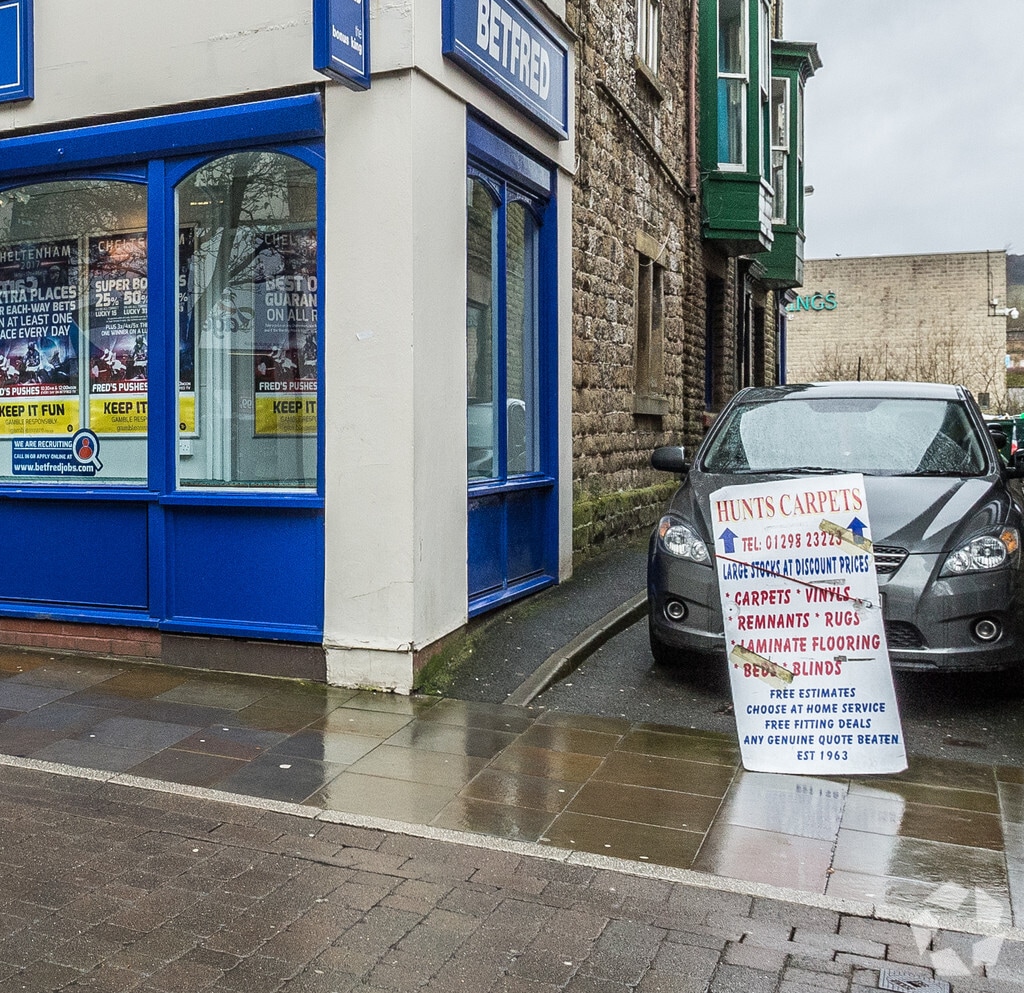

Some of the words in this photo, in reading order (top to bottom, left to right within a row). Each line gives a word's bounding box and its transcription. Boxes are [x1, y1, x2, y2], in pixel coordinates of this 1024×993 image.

[20, 260, 40, 270] 2017
[96, 278, 130, 292] SUPER
[265, 276, 303, 292] BEST
[30, 285, 76, 302] PLACES
[96, 293, 119, 307] 25%
[6, 302, 50, 315] EACH-WAY
[53, 300, 76, 312] BETS
[7, 316, 18, 328] AT
[20, 314, 49, 326] LEAST
[52, 312, 72, 324] ONE
[267, 309, 284, 322] ON
[288, 309, 308, 322] ALL
[18, 326, 48, 338] EVERY
[52, 325, 71, 336] DAY
[12, 386, 40, 396] PUSHES
[92, 383, 118, 392] FRED'S
[118, 382, 148, 392] PUSHES
[259, 382, 288, 390] FRED'S
[290, 382, 318, 390] PUSHES
[0, 405, 24, 417] KEEP
[28, 404, 38, 416] IT
[42, 404, 64, 416] FUN
[104, 402, 132, 414] KEEP
[273, 401, 302, 414] KEEP
[14, 462, 94, 474] www.betfredjobs.com
[716, 495, 776, 523] HUNTS
[779, 488, 863, 516] CARPETS
[742, 536, 762, 552] TEL:
[766, 533, 801, 550] 01298
[723, 561, 748, 581] LARGE
[750, 559, 780, 579] STOCKS
[783, 558, 794, 576] AT
[796, 556, 837, 576] DISCOUNT
[840, 554, 869, 574] PRICES
[734, 589, 792, 606] CARPETS
[806, 586, 850, 604] VINYLS
[738, 612, 810, 630] REMNANTS
[825, 611, 860, 628] RUGS
[812, 634, 880, 652] FLOORING
[792, 660, 842, 676] BLINDS
[770, 689, 794, 699] FREE
[799, 688, 856, 698] ESTIMATES
[746, 704, 787, 714] CHOOSE
[790, 704, 802, 714] AT
[806, 704, 838, 714] HOME
[842, 702, 886, 712] SERVICE
[765, 720, 790, 730] FREE
[794, 719, 834, 730] FITTING
[838, 718, 872, 728] DEALS
[744, 736, 764, 745] ANY
[768, 735, 814, 745] GENUINE
[818, 735, 854, 745] QUOTE
[858, 734, 899, 744] BEATEN
[797, 751, 816, 760] EST
[820, 750, 848, 760] 1963
